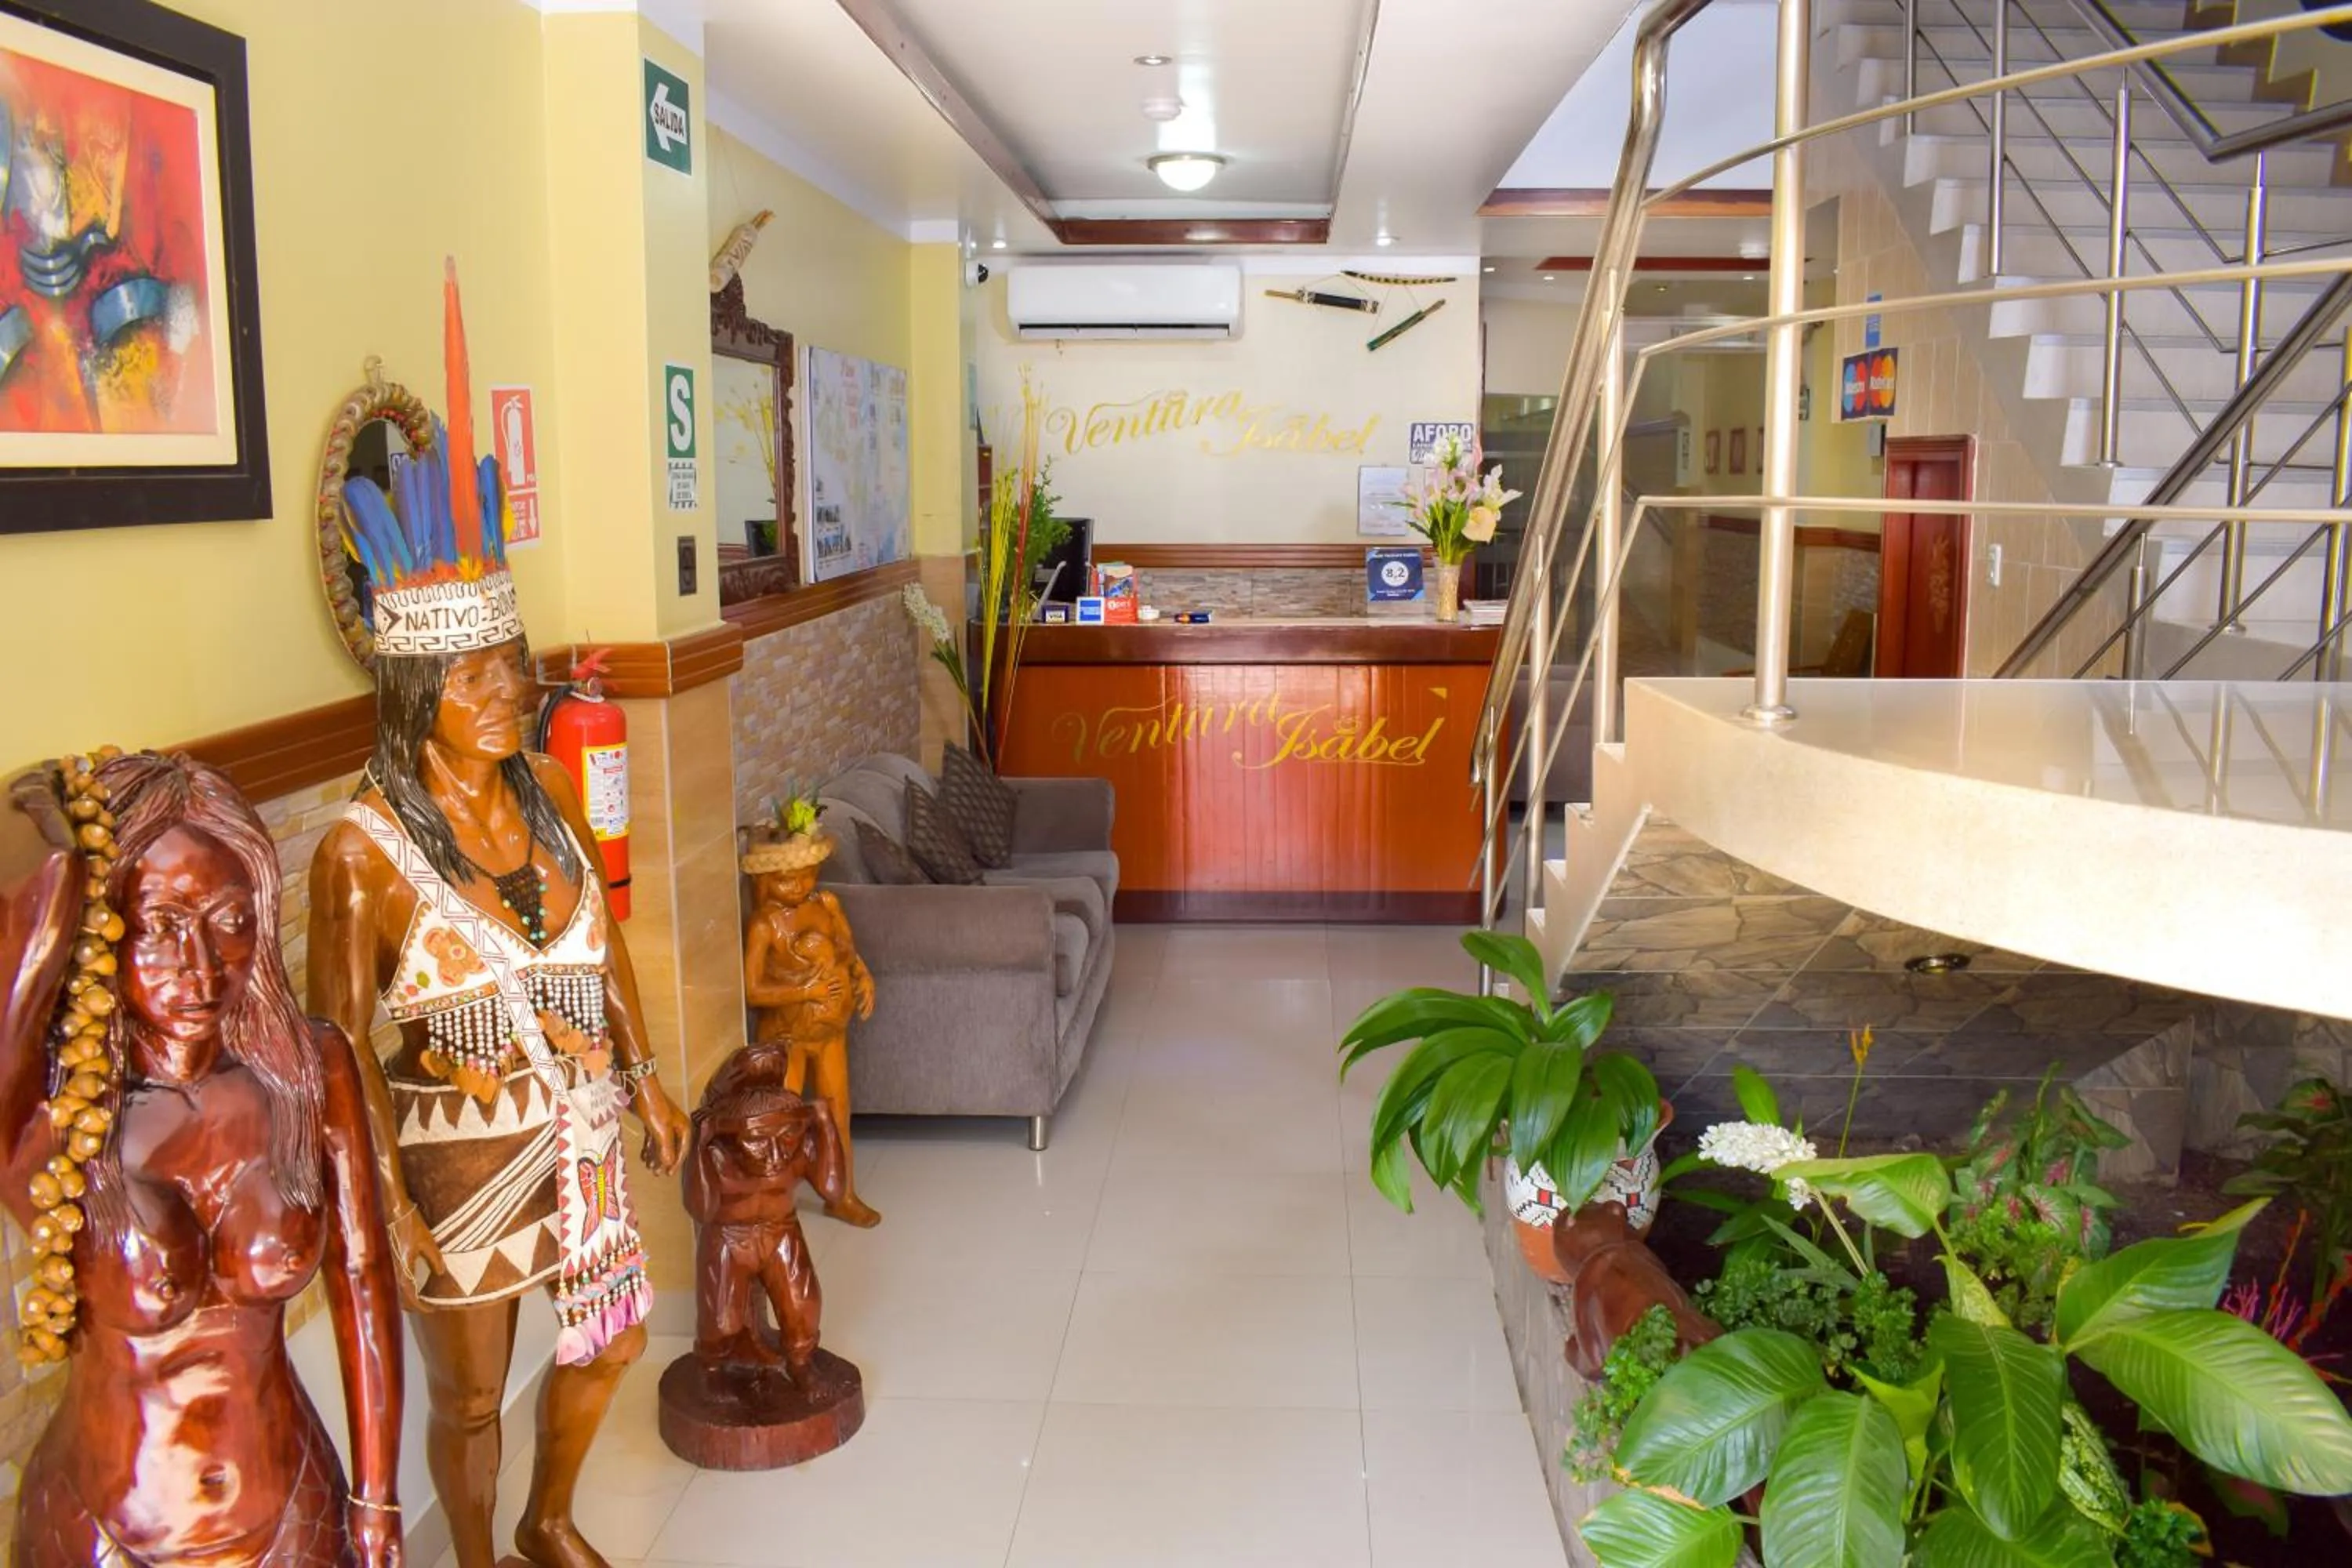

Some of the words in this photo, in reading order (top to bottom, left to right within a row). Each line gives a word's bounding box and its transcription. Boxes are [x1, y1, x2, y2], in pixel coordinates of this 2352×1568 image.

[654, 103, 684, 137] SALIDA
[670, 374, 691, 452] S
[1046, 390, 1243, 455] Ventura
[1200, 405, 1381, 457] Isabel
[1052, 691, 1280, 765] Ventura
[1231, 703, 1445, 769] Isabel
